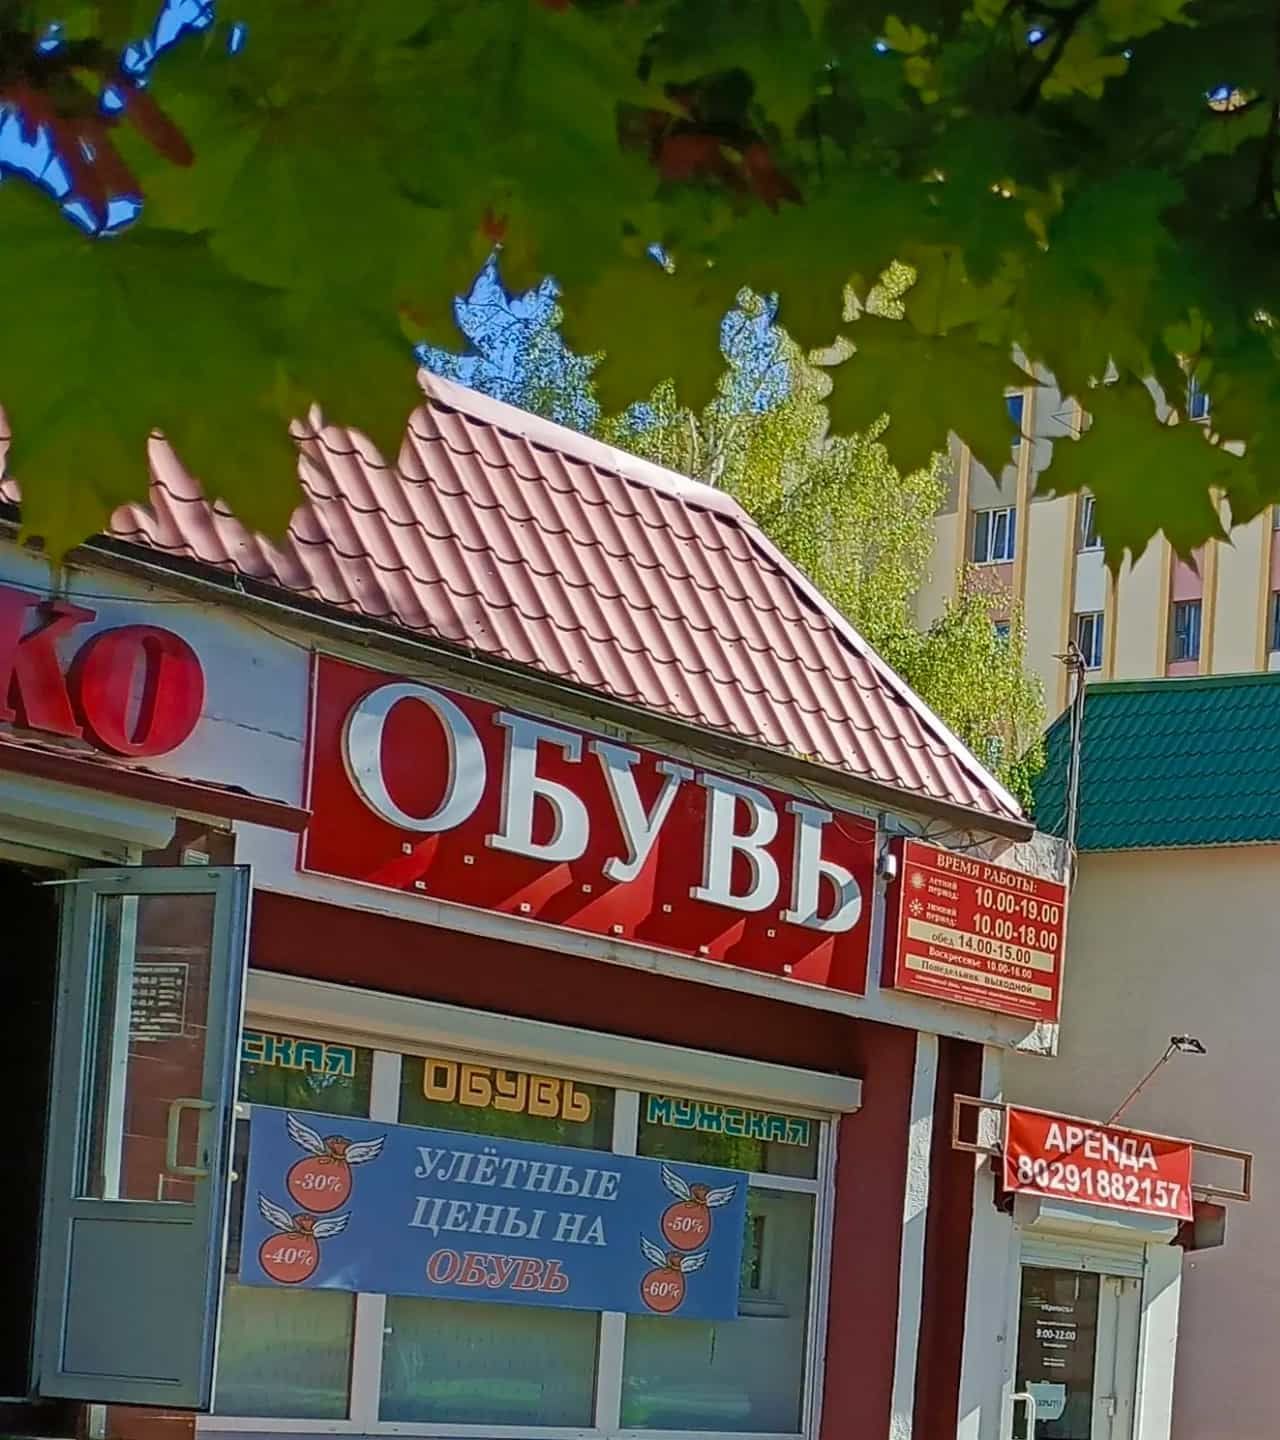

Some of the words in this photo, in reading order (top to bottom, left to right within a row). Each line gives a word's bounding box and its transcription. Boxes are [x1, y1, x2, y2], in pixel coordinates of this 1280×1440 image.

[341, 682, 862, 934] ОБУВЬ
[936, 853, 980, 877] ВРЕМЯ
[984, 866, 1037, 893] РАБОТЫ:
[976, 886, 1059, 925] 10.00-19.00
[931, 932, 955, 948] обед
[958, 934, 1031, 964] 14.00-15.00
[973, 912, 1058, 950] 10.00-18.00
[423, 1057, 591, 1122] ОБУВЬ
[647, 1094, 810, 1147] МУЖСКАЯ
[1044, 1122, 1158, 1172] АРЕНДА
[295, 1173, 343, 1192] -30%
[414, 1146, 621, 1200] УЛЁТНЫЕ
[1017, 1154, 1181, 1210] 80291882157
[408, 1196, 547, 1239] ЦЕНЫ
[552, 1212, 608, 1246] НА
[667, 1217, 704, 1233] -50%
[265, 1247, 313, 1266] -40%
[426, 1248, 569, 1293] ОБУВЬ
[644, 1281, 681, 1298] -60%
